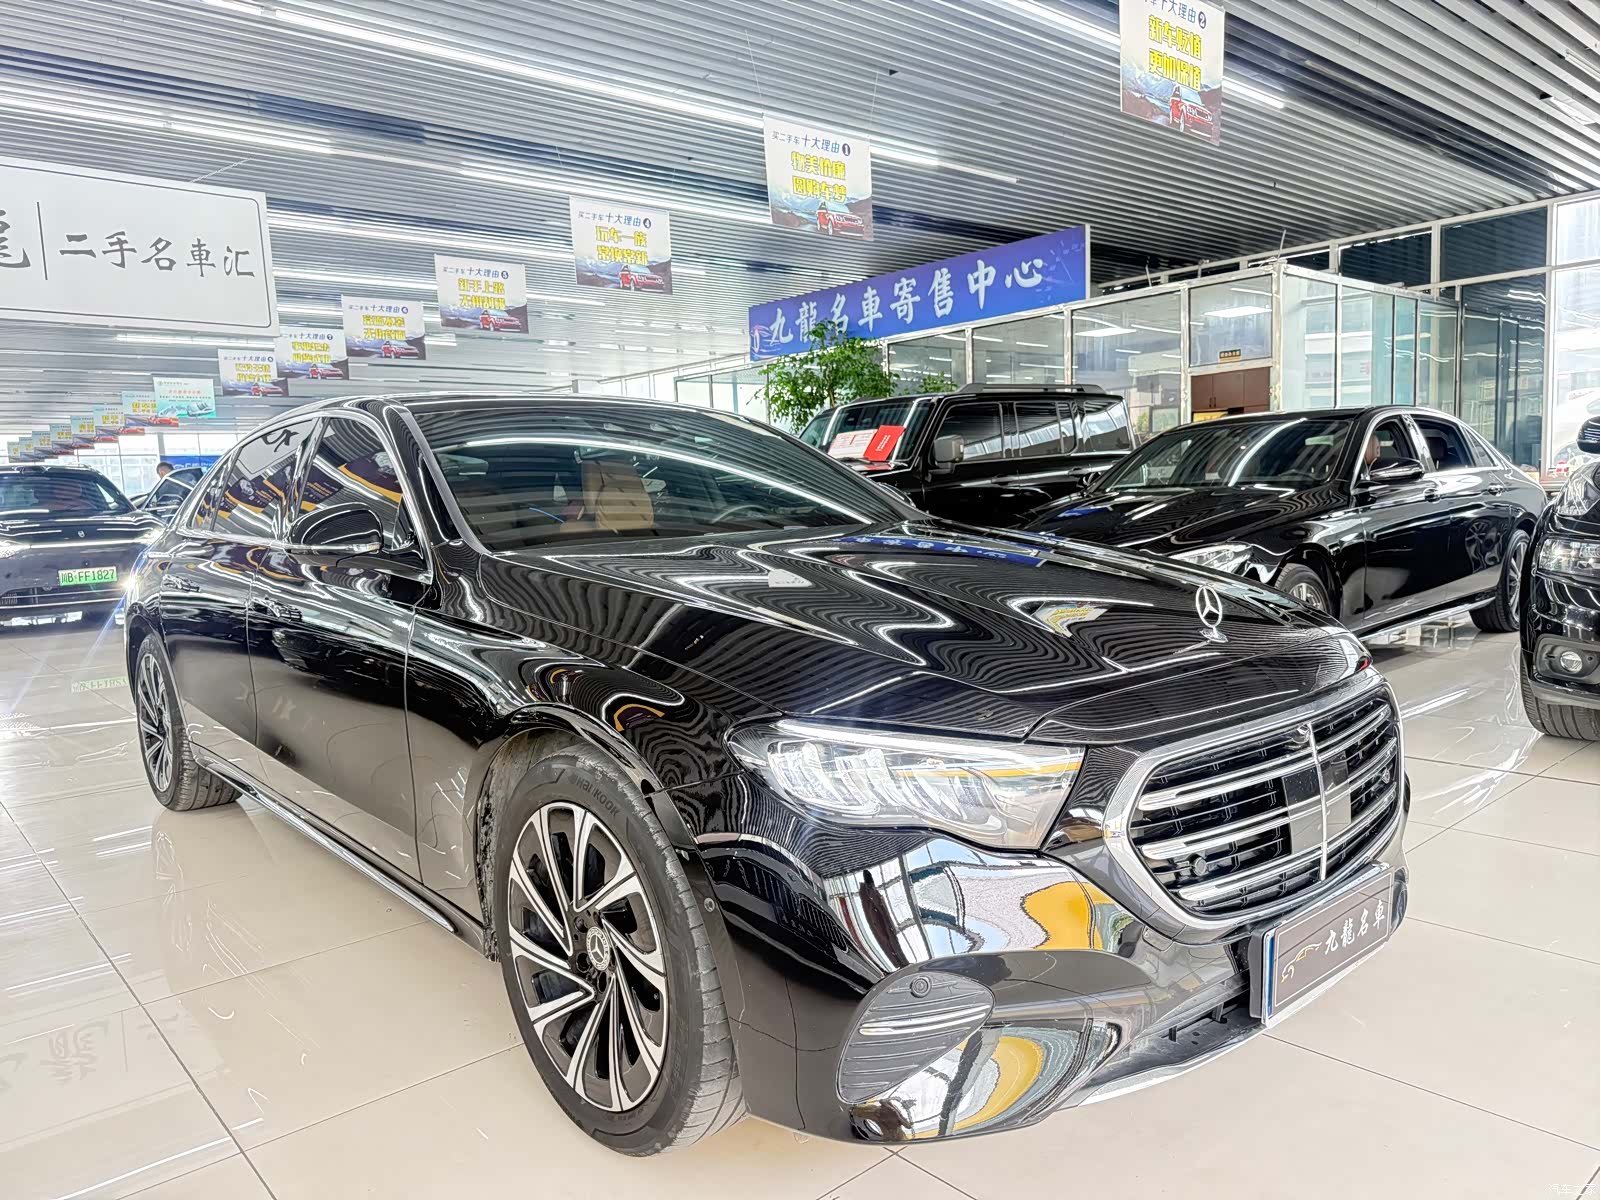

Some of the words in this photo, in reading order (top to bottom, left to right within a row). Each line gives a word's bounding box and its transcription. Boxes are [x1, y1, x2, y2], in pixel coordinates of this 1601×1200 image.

[1149, 14, 1202, 61] 新车贬值
[1149, 48, 1202, 92] 更加保值
[772, 130, 840, 154] 买二手车十大理由
[791, 150, 846, 180] 物美价廉
[792, 175, 847, 204] 圆购车梦
[59, 231, 255, 278] 二手名車汇
[595, 225, 647, 247] 玩车一族
[458, 277, 505, 296] 新手上路
[769, 257, 1044, 344] 九龍名車寄售中心
[1324, 899, 1386, 955] 九龍名車
